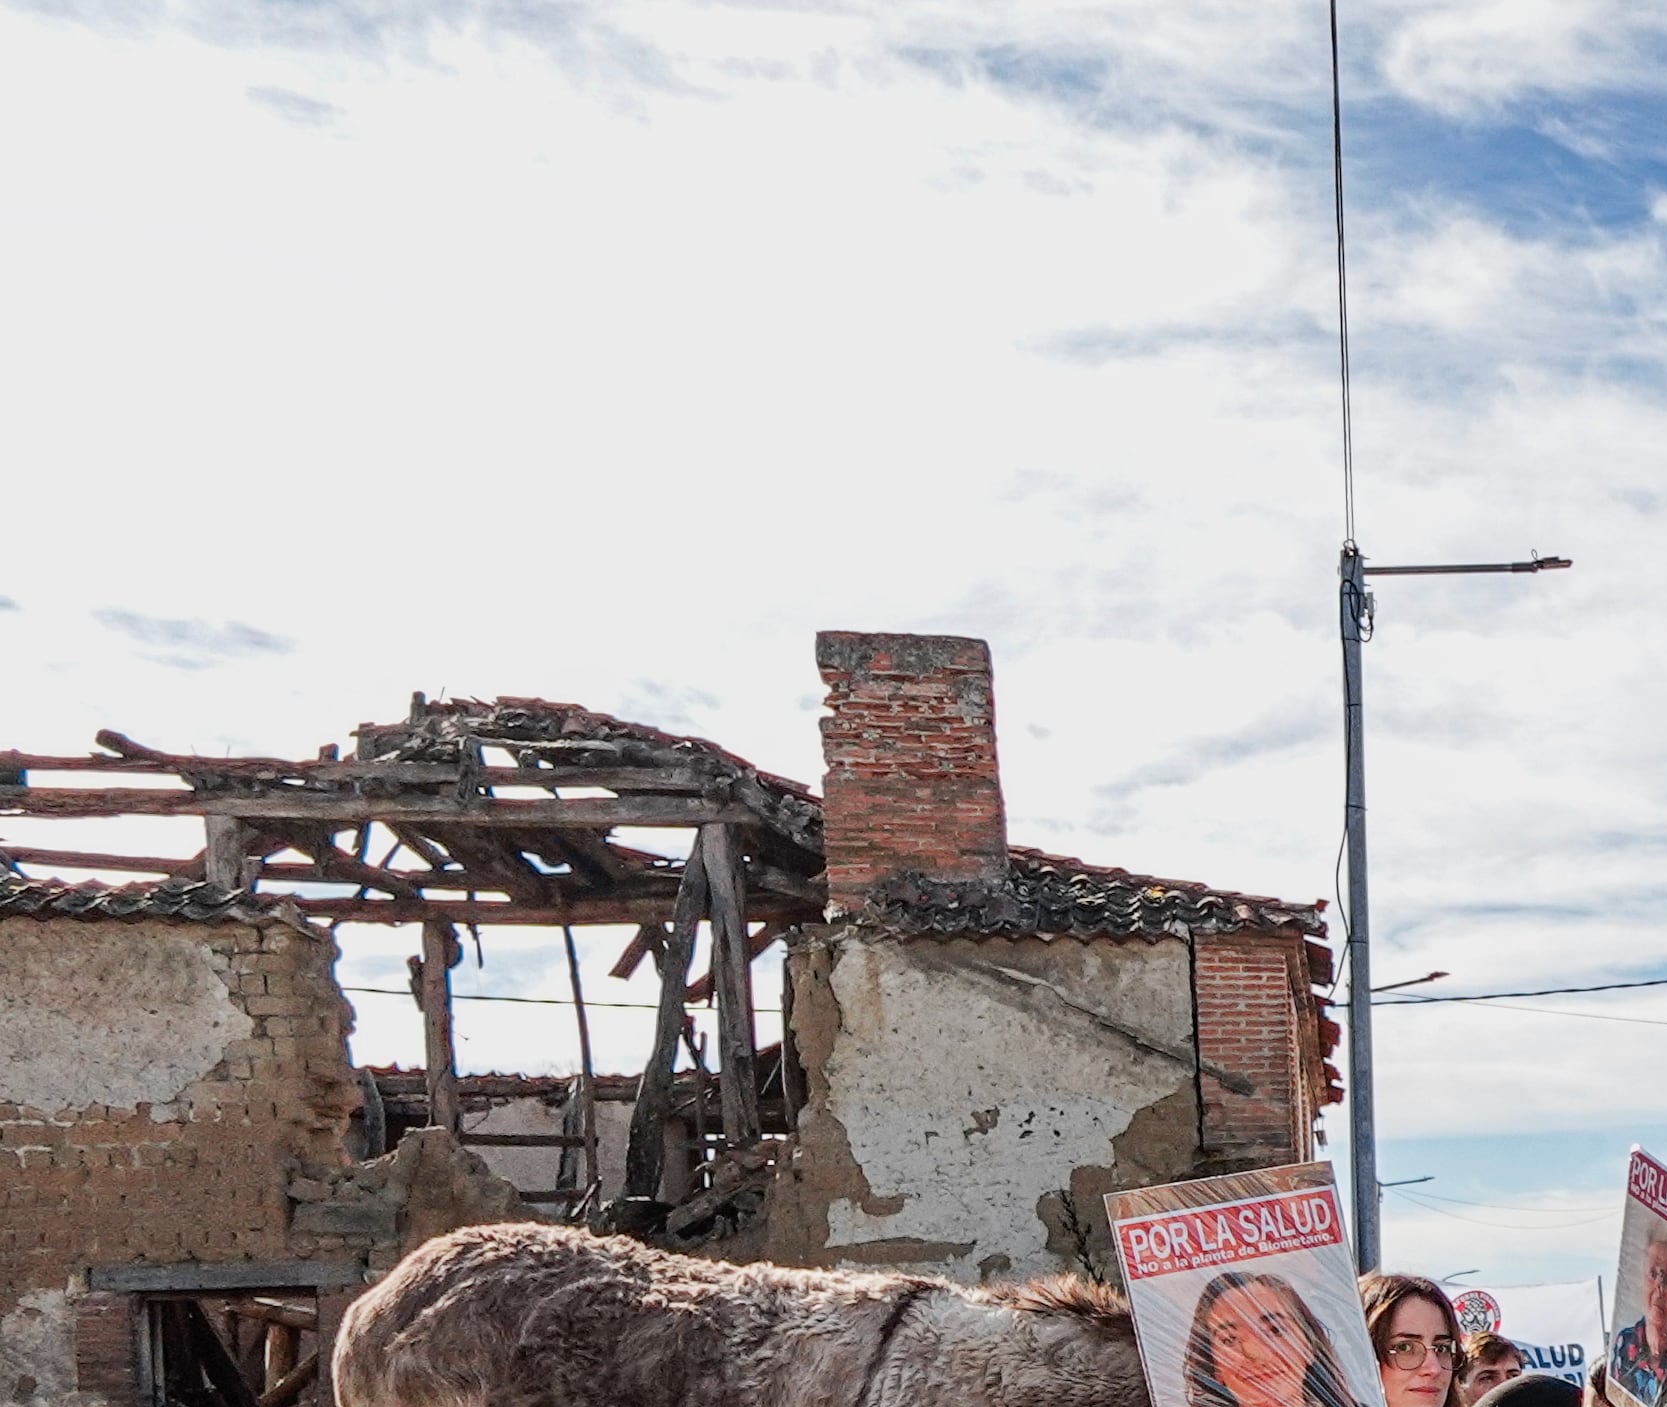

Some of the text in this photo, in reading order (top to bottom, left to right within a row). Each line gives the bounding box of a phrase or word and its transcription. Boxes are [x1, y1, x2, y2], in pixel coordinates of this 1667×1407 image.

[1631, 1156, 1658, 1198] POR
[1128, 1197, 1332, 1263] POR LA SALUD
[1137, 1231, 1335, 1275] NO a la planta de Biometano.
[1521, 1343, 1585, 1369] ALUD
